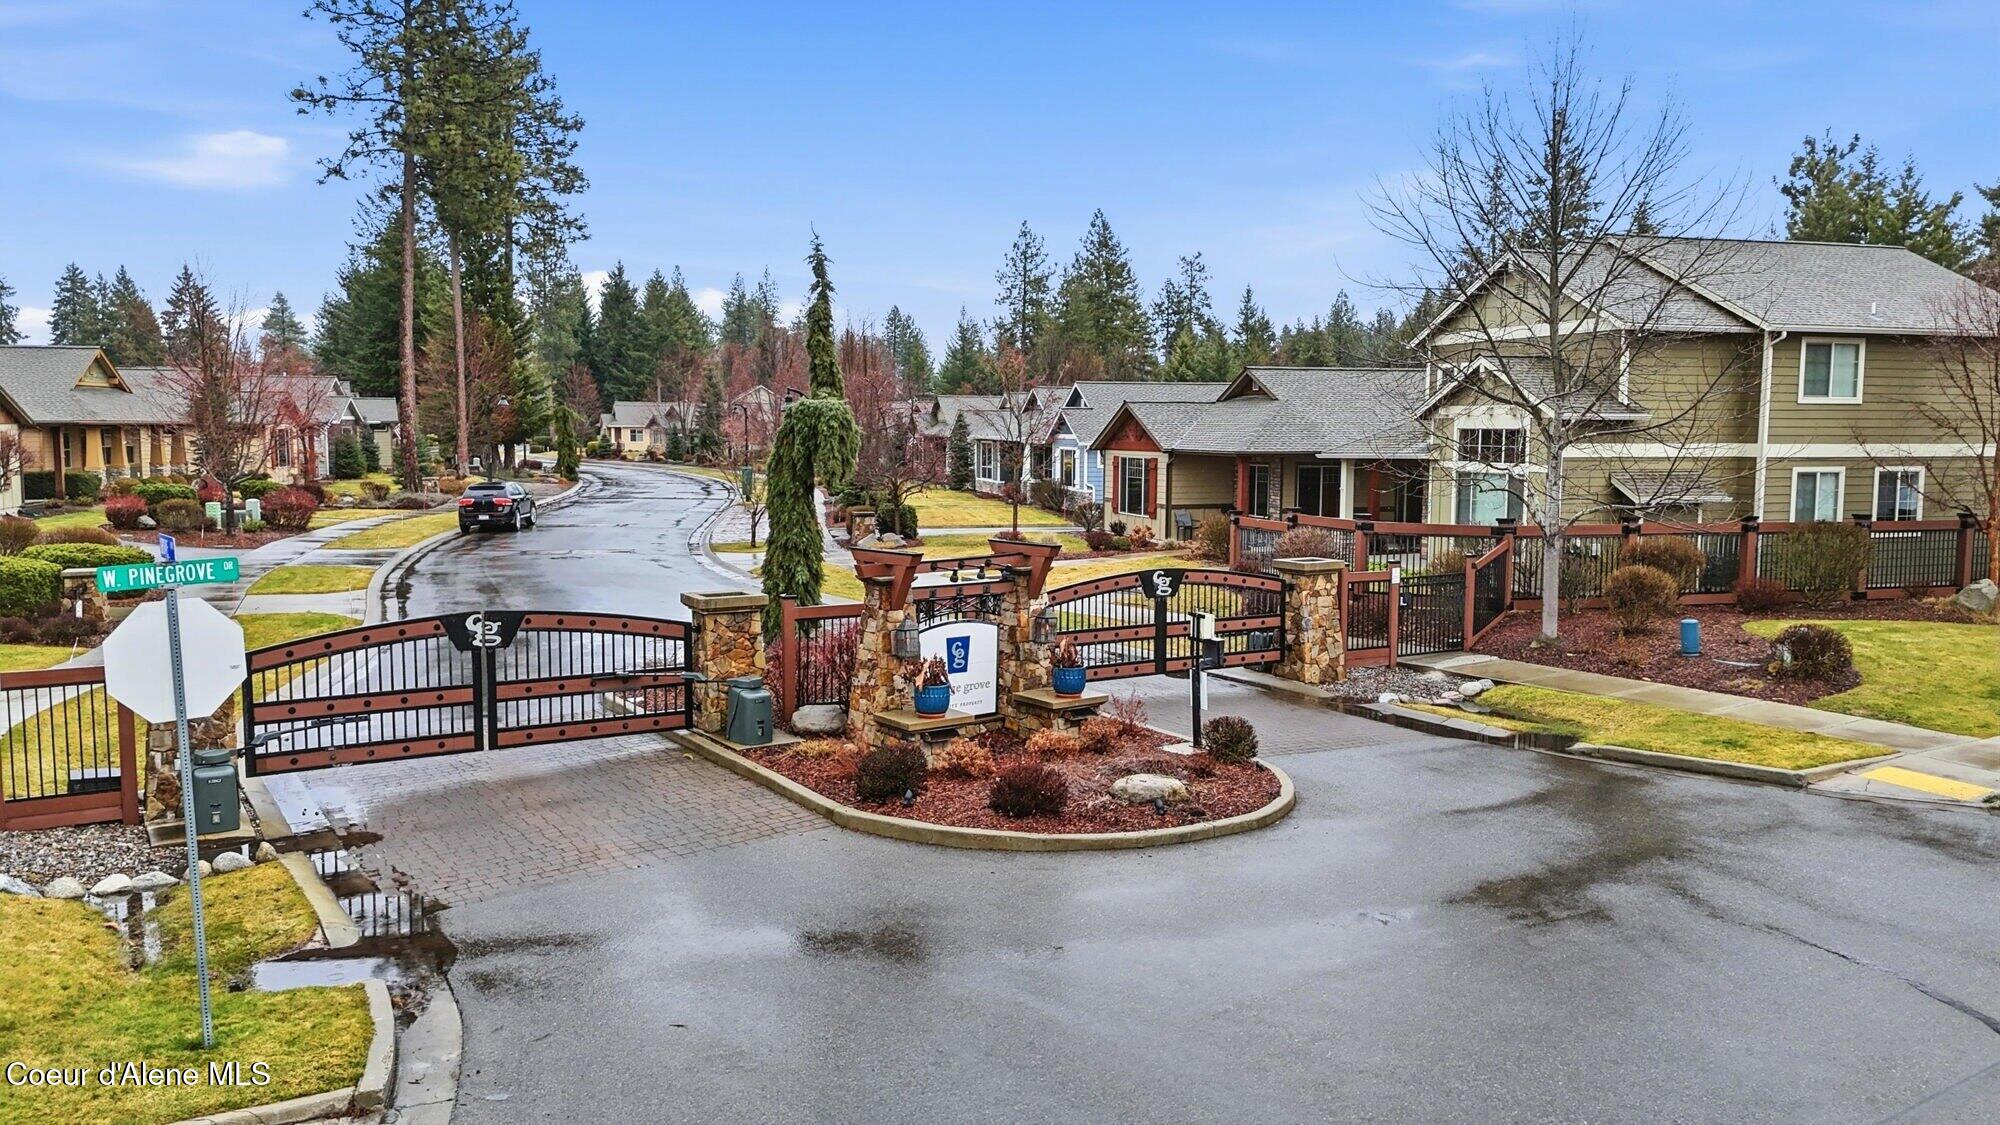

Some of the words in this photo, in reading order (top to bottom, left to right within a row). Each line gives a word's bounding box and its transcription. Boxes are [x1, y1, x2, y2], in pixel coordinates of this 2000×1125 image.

[103, 569, 122, 588] W.
[128, 562, 216, 586] PINEGROVE
[223, 561, 234, 571] DR
[963, 680, 991, 695] grove
